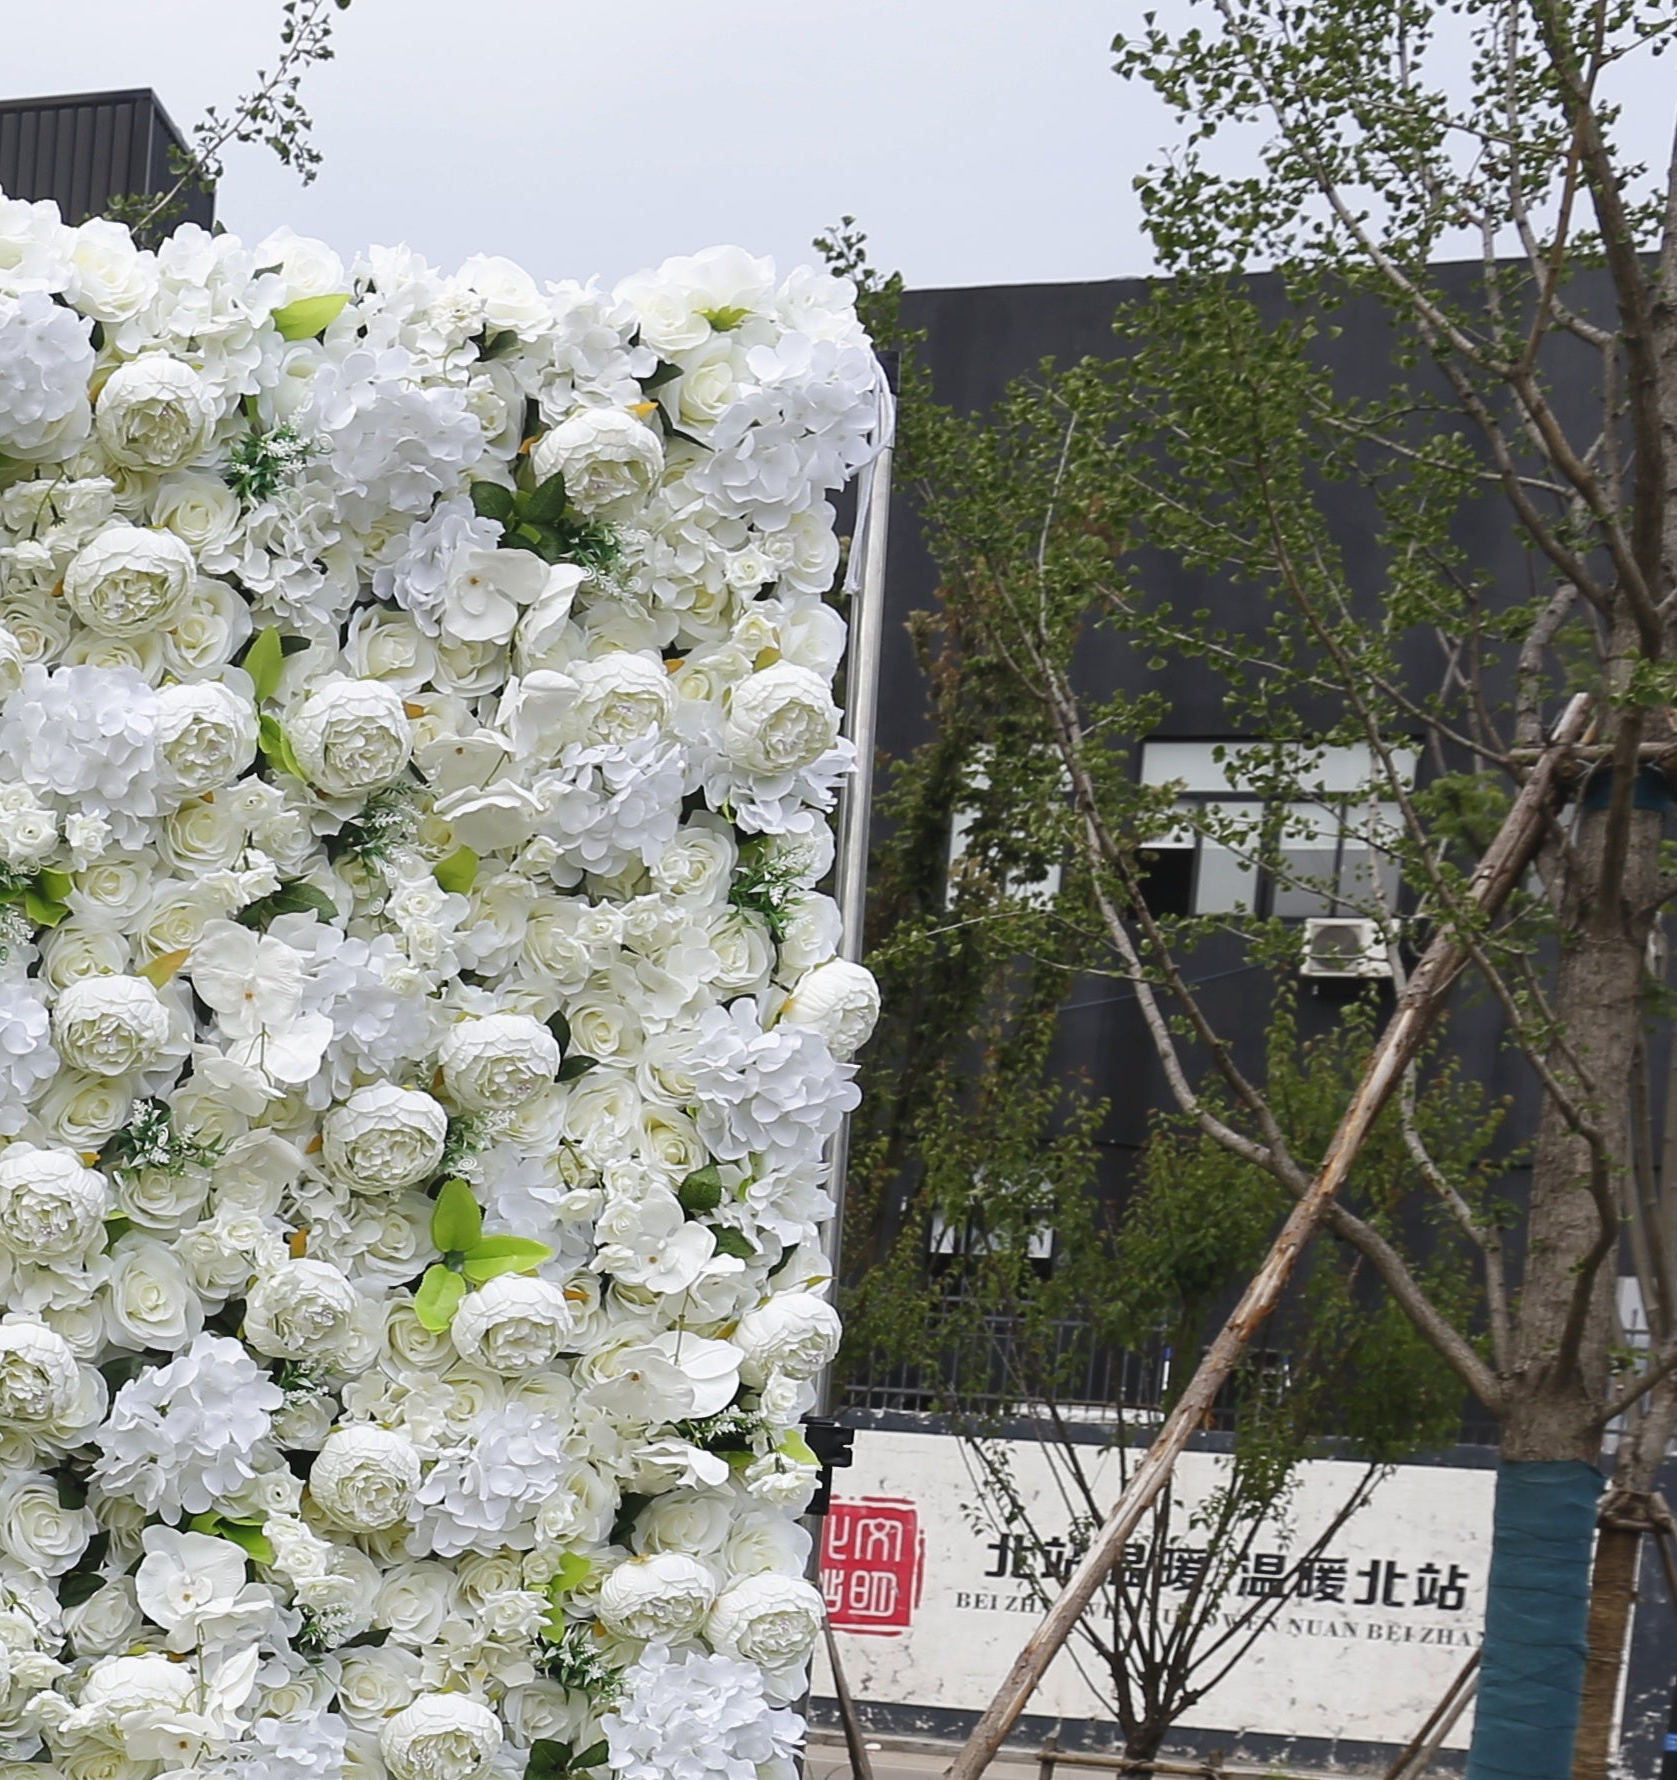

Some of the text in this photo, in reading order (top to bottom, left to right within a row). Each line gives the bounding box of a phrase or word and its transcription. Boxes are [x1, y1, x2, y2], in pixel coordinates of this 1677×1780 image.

[1235, 1552, 1471, 1611] 温暖北站
[955, 1591, 998, 1611] BEI
[1286, 1617, 1359, 1639] NUAN
[1366, 1622, 1413, 1644] BEI
